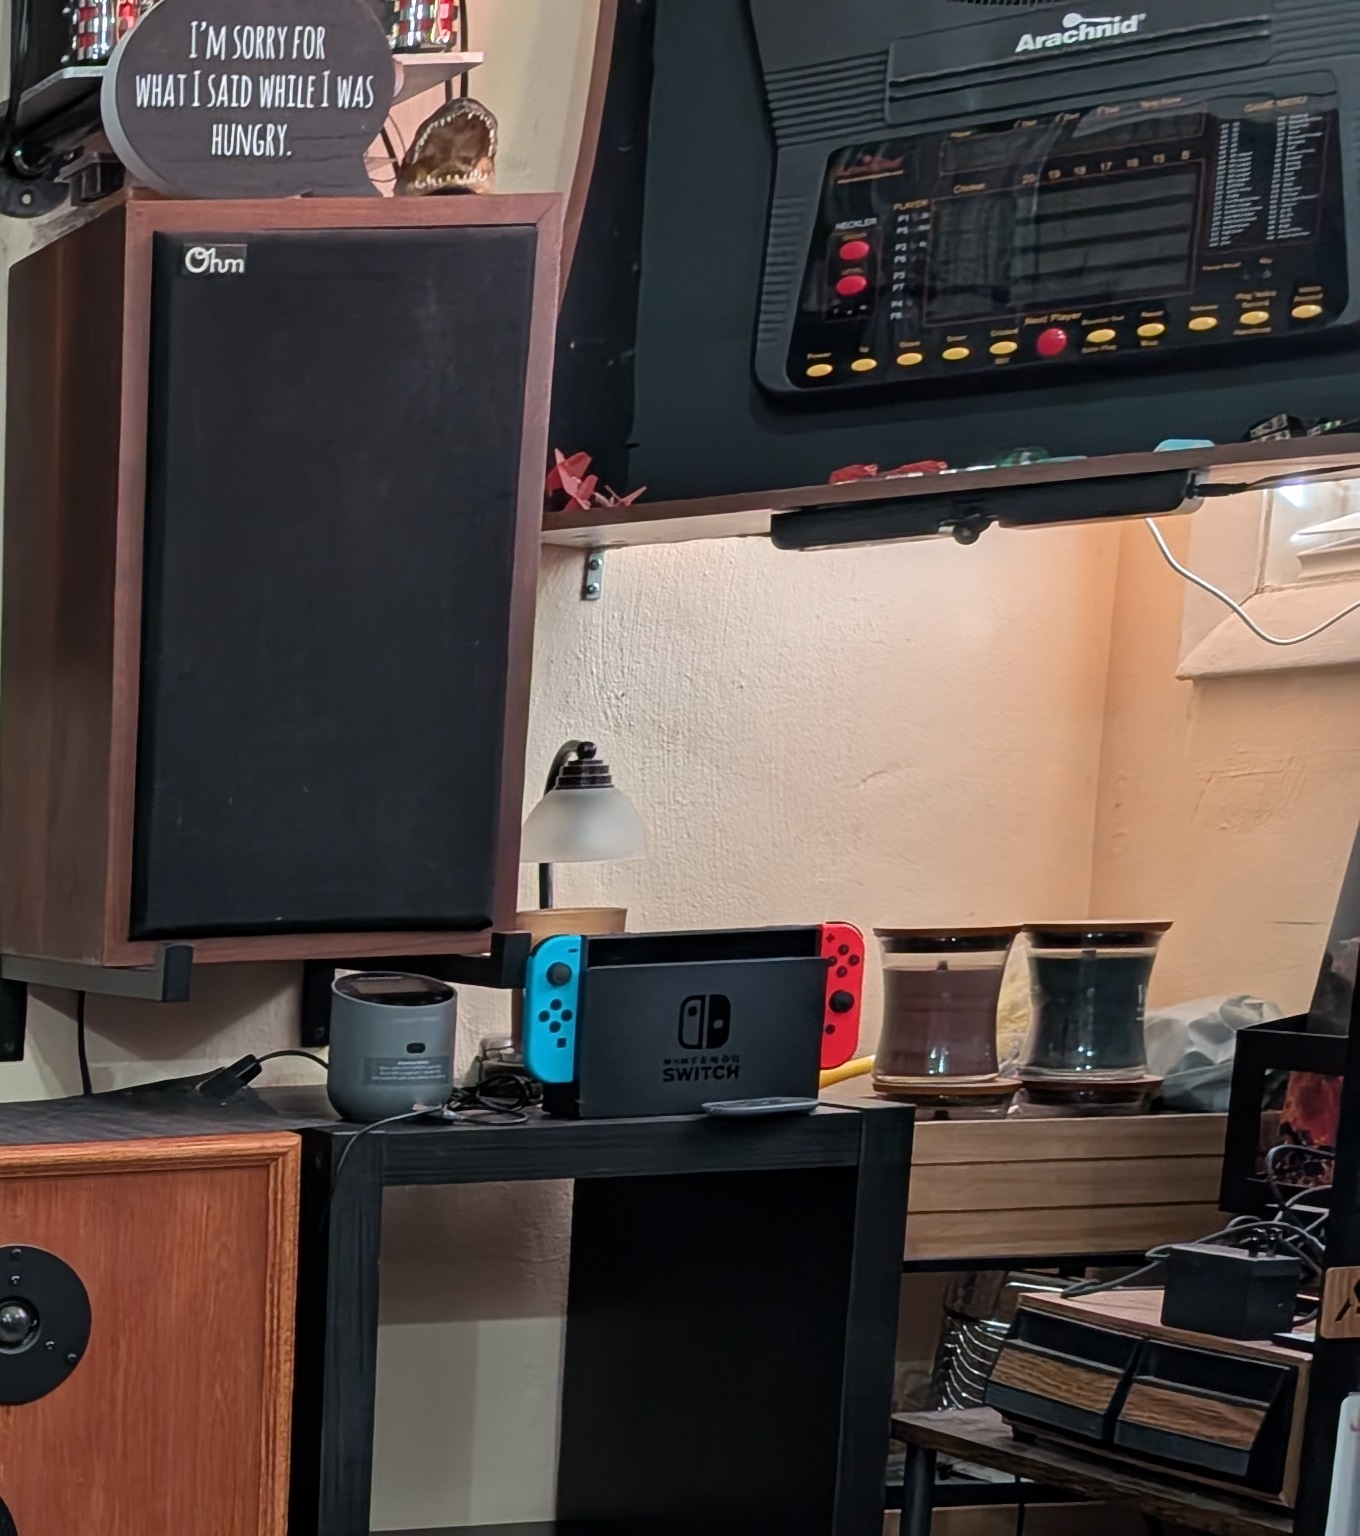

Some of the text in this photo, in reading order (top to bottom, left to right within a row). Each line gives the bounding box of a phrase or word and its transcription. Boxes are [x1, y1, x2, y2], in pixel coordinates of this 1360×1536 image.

[188, 20, 326, 61] I'M SORRY FOR
[1015, 12, 1140, 53] Arachnid
[136, 70, 375, 109] WHAT I SAID WHILE I WAS
[211, 123, 292, 156] HUNGRY.
[184, 246, 245, 274] Ohm
[662, 1064, 740, 1082] SWITCH
